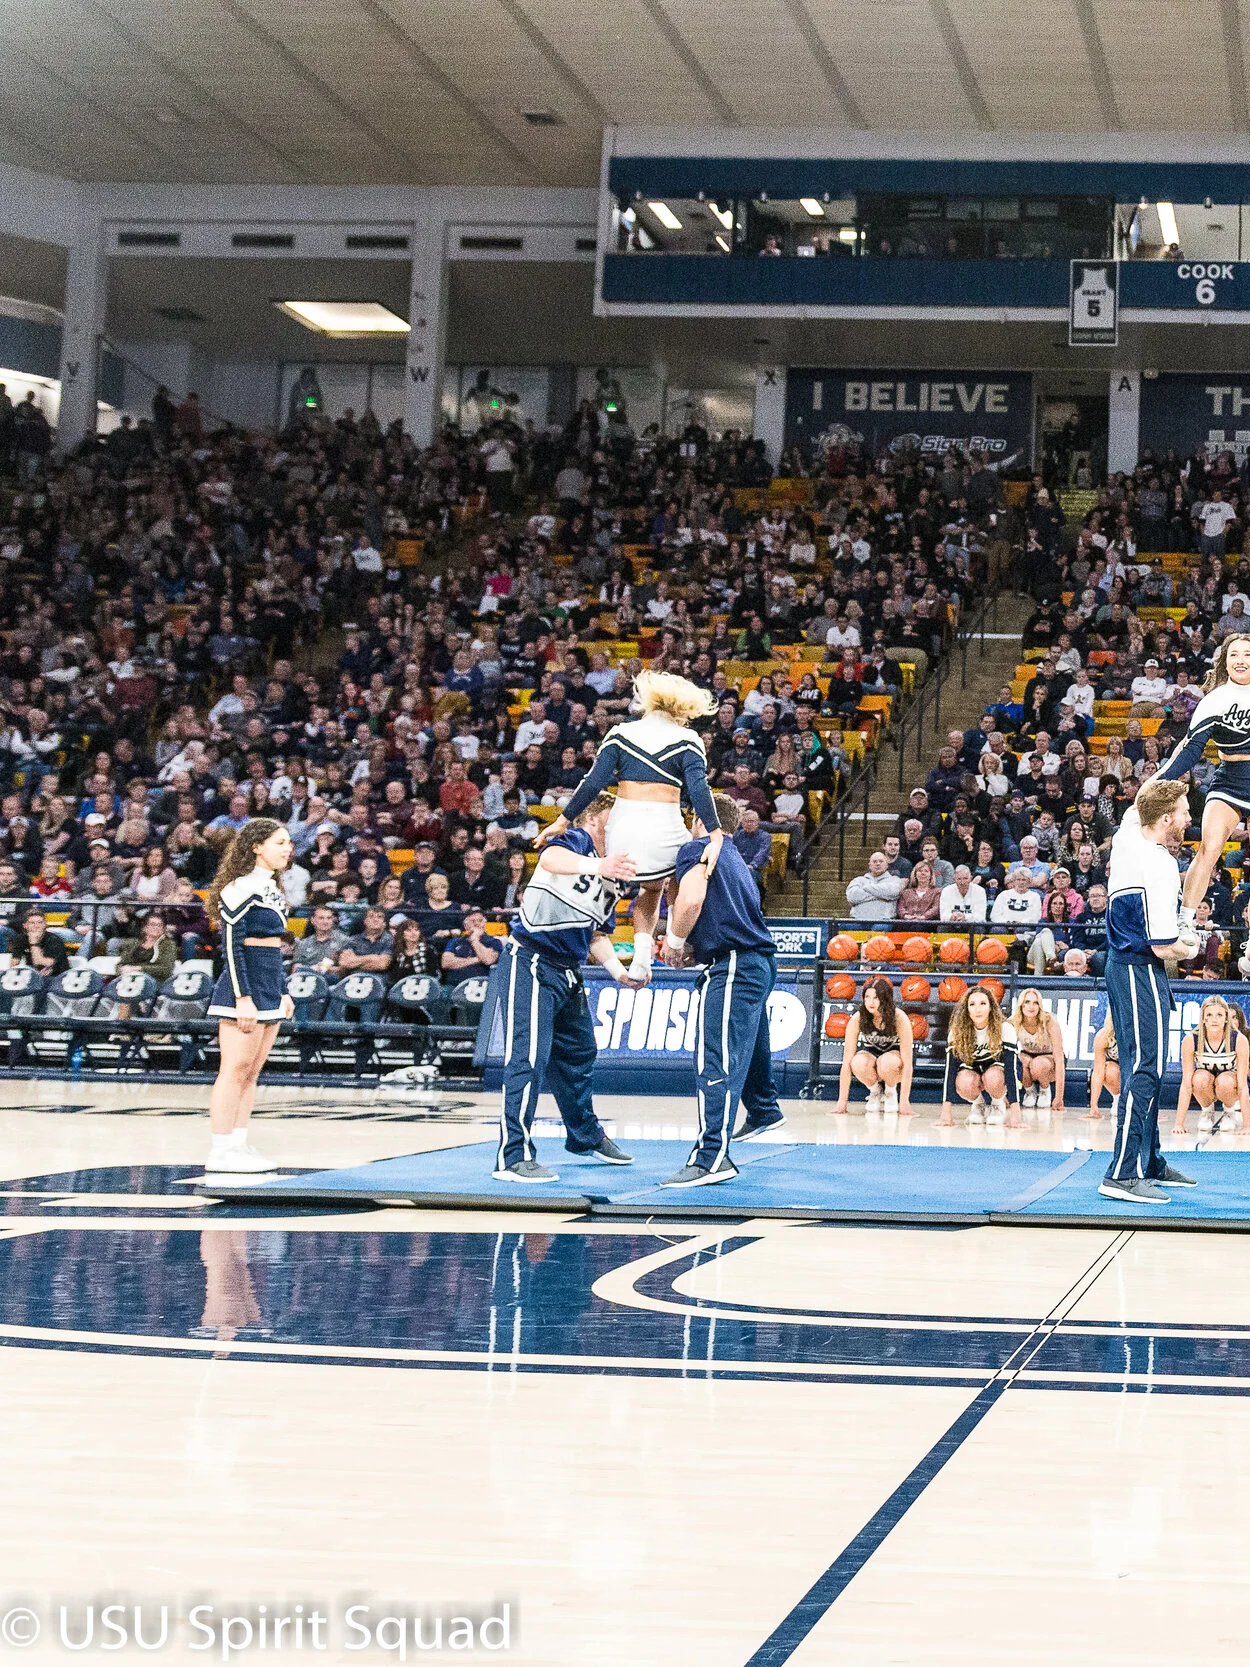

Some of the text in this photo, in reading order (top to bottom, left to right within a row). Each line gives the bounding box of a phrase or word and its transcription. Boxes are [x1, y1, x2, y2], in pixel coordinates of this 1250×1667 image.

[1177, 264, 1234, 280] COOK
[1195, 279, 1216, 304] 6
[1087, 300, 1101, 317] 5
[409, 366, 430, 382] W
[764, 370, 777, 386] X
[1117, 376, 1132, 392] A
[812, 381, 1009, 413] I BELIEVE
[594, 987, 699, 1052] SPONS
